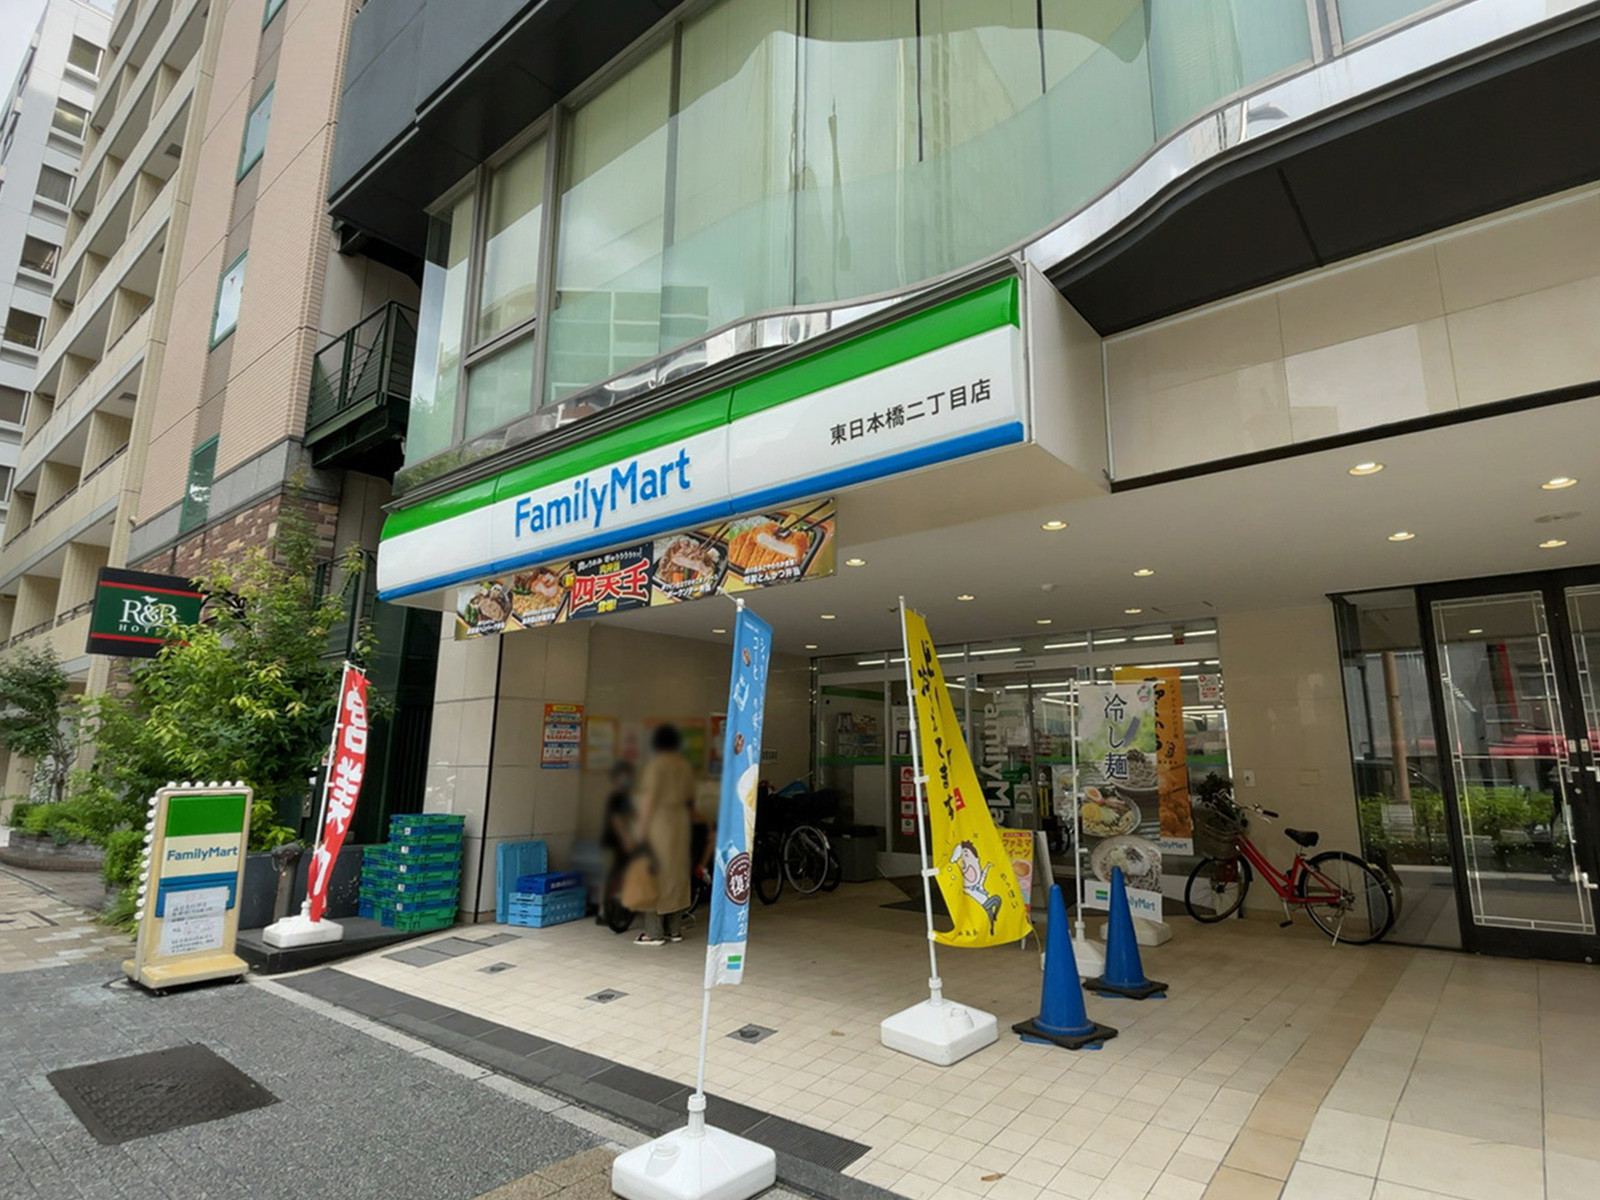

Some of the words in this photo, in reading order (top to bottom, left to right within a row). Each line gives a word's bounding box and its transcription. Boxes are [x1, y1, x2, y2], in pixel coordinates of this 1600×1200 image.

[829, 378, 991, 446] 東日本橋二丁目店
[514, 447, 691, 538] FamilyMart
[120, 599, 178, 627] R&B
[568, 557, 650, 617] 四天王
[1104, 693, 1129, 781] 冷し麺
[166, 845, 239, 862] FamilyMart
